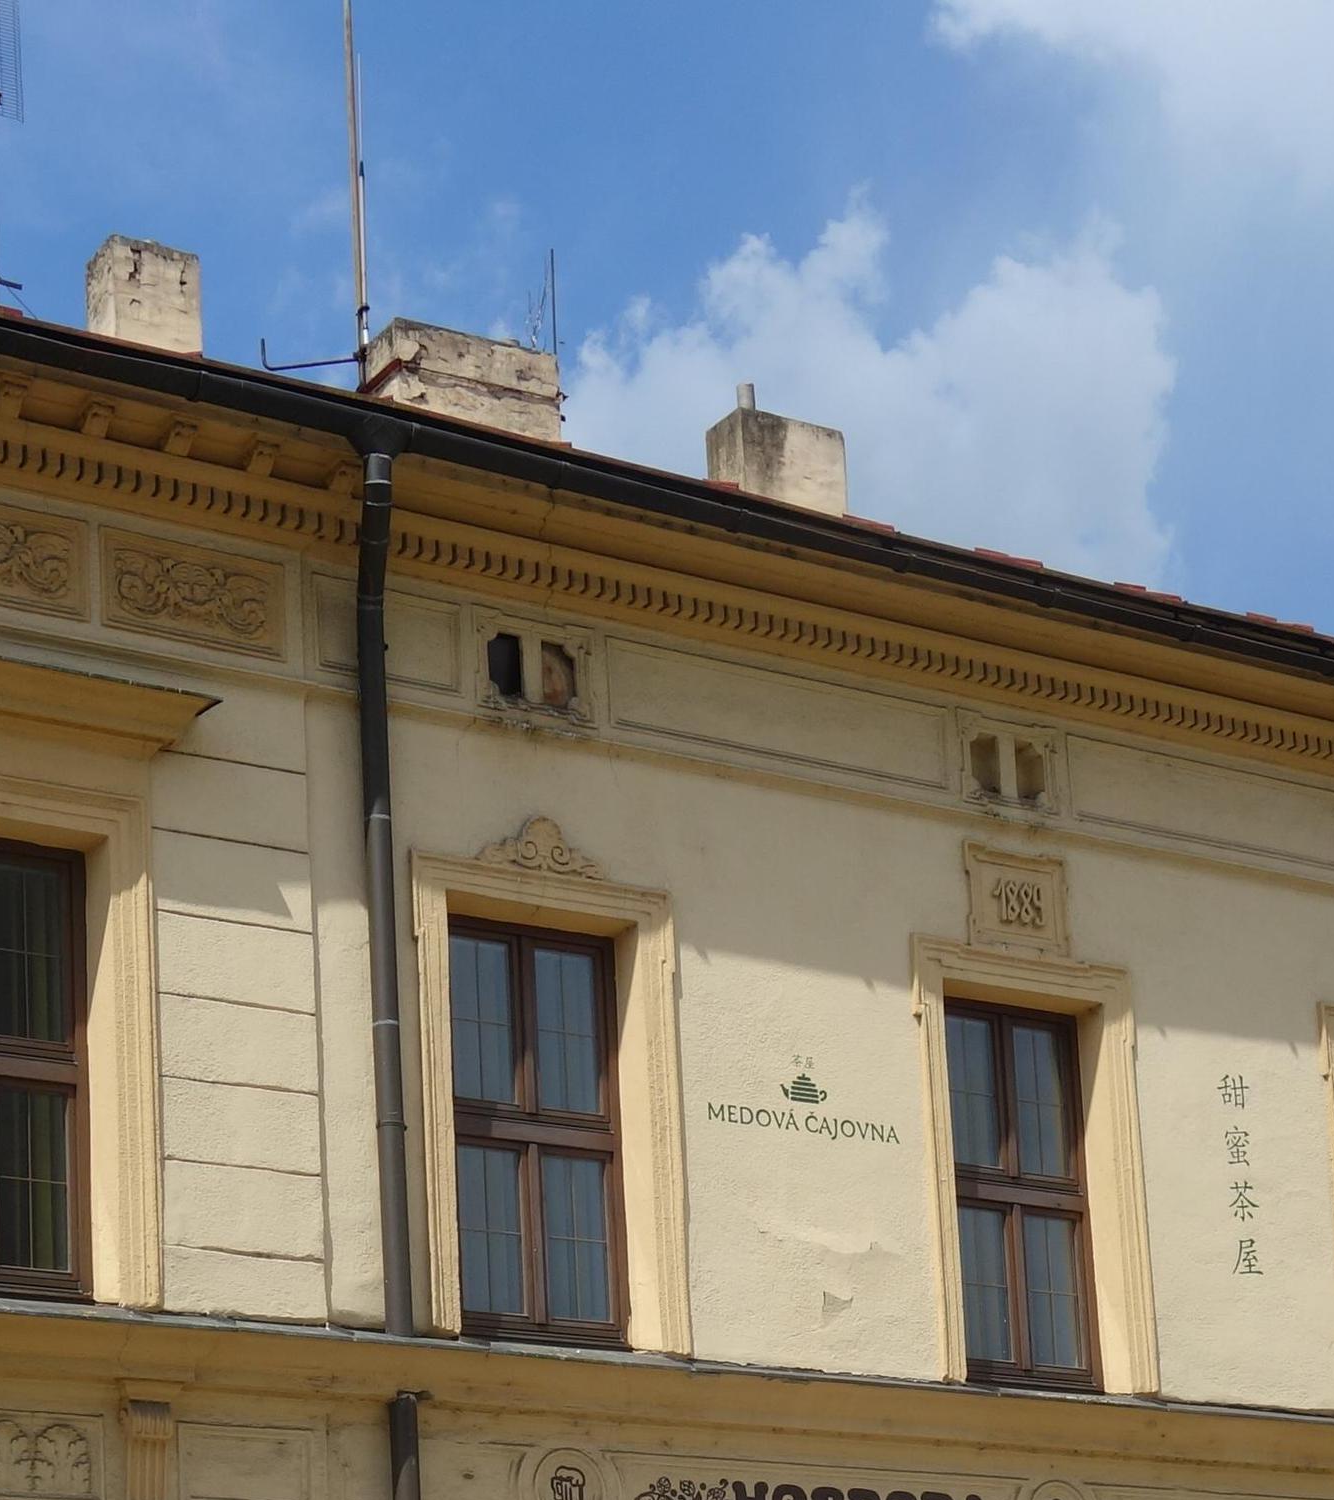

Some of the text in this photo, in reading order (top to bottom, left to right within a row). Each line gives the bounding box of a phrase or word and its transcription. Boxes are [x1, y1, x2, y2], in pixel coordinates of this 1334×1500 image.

[993, 876, 1045, 926] 1889
[707, 1102, 901, 1145] MEDOVÁ ČAJOVNA
[1217, 1073, 1264, 1276] 甜蜜茶屋
